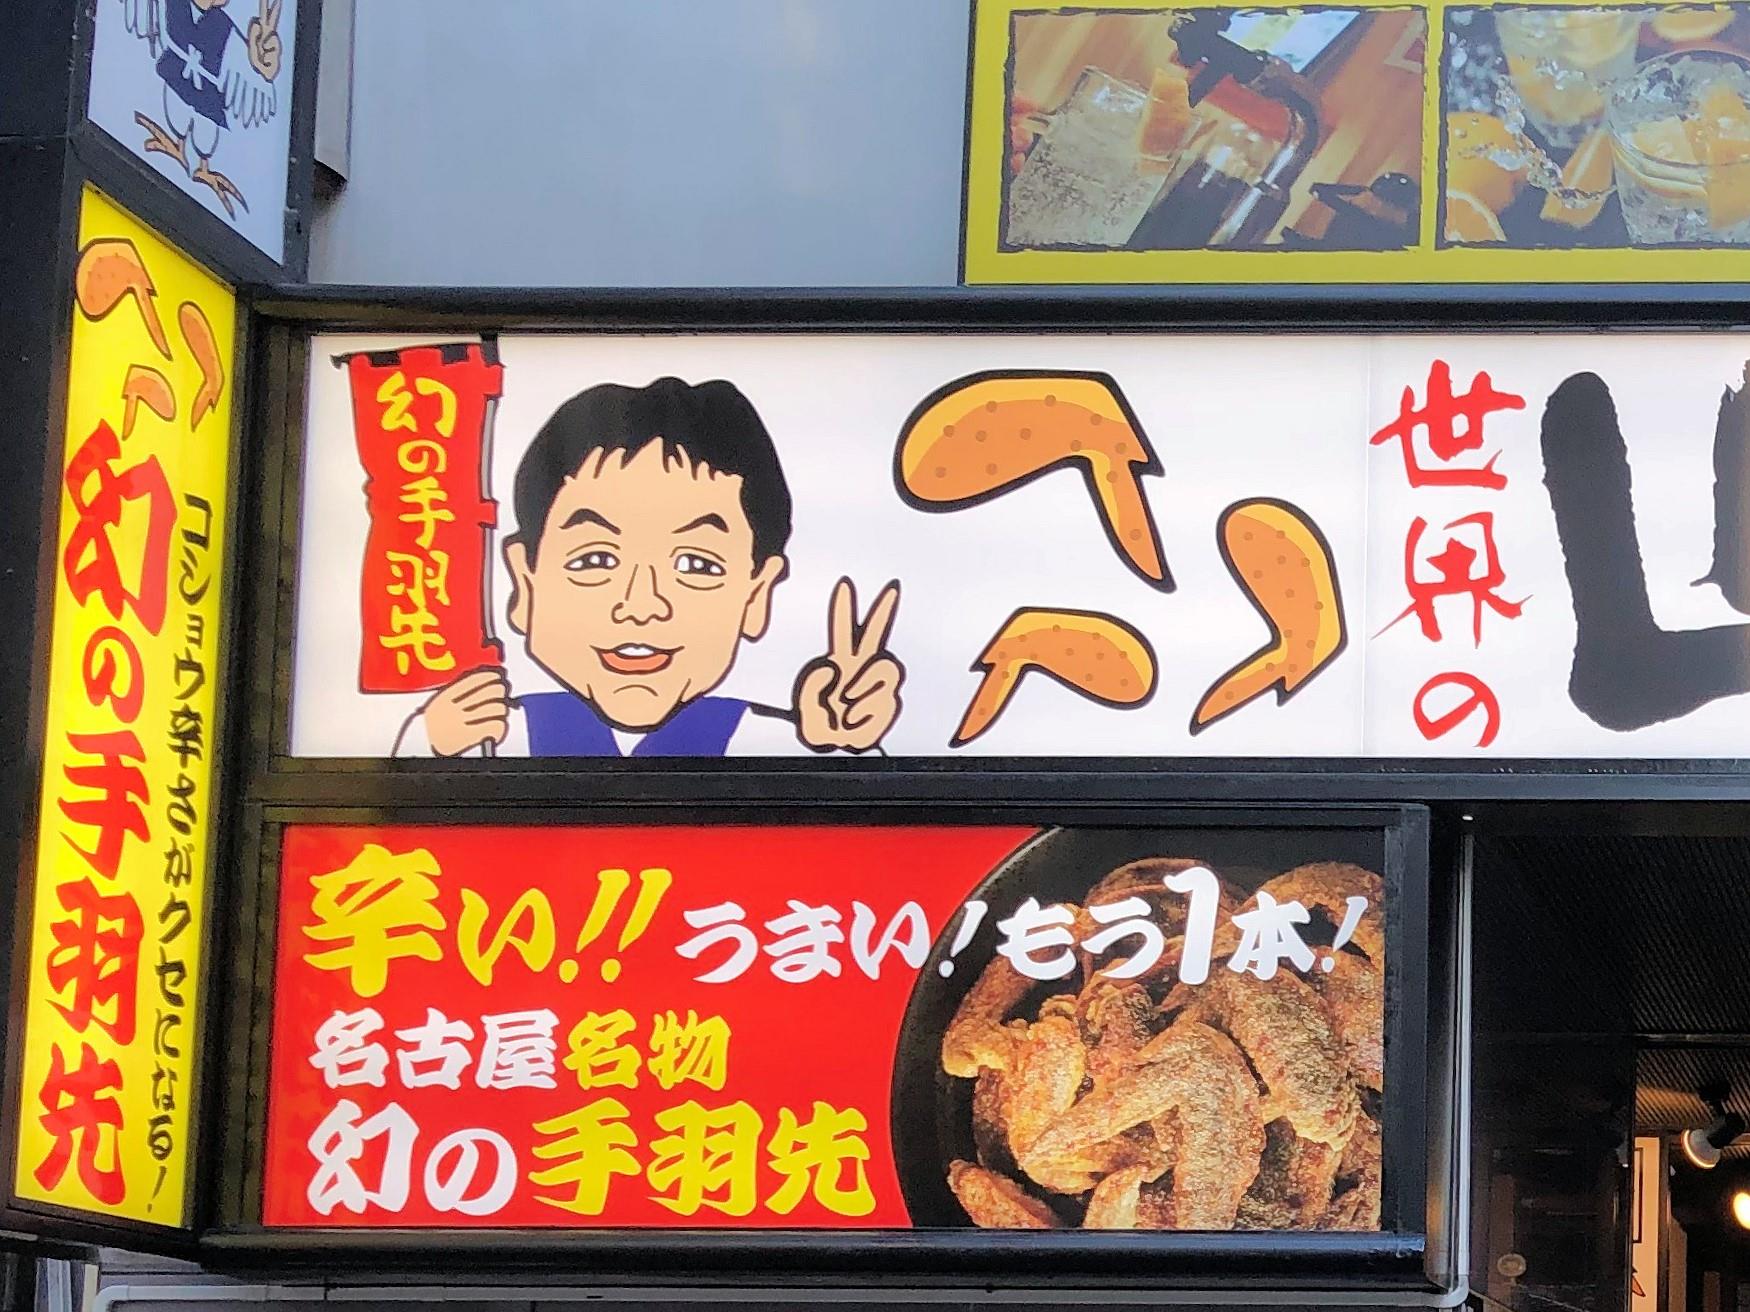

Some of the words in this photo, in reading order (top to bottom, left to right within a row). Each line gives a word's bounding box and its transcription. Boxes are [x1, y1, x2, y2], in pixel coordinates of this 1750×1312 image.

[376, 373, 457, 673] 幻の手羽先
[1370, 359, 1532, 747] 世界の
[33, 418, 178, 1206] 幻の手羽先
[302, 843, 673, 999] 辛い!!
[676, 896, 988, 986] うまい!
[995, 866, 1371, 987] もう1本!
[307, 1099, 877, 1219] 幻の手羽先
[309, 1009, 733, 1094] 名古屋名物
